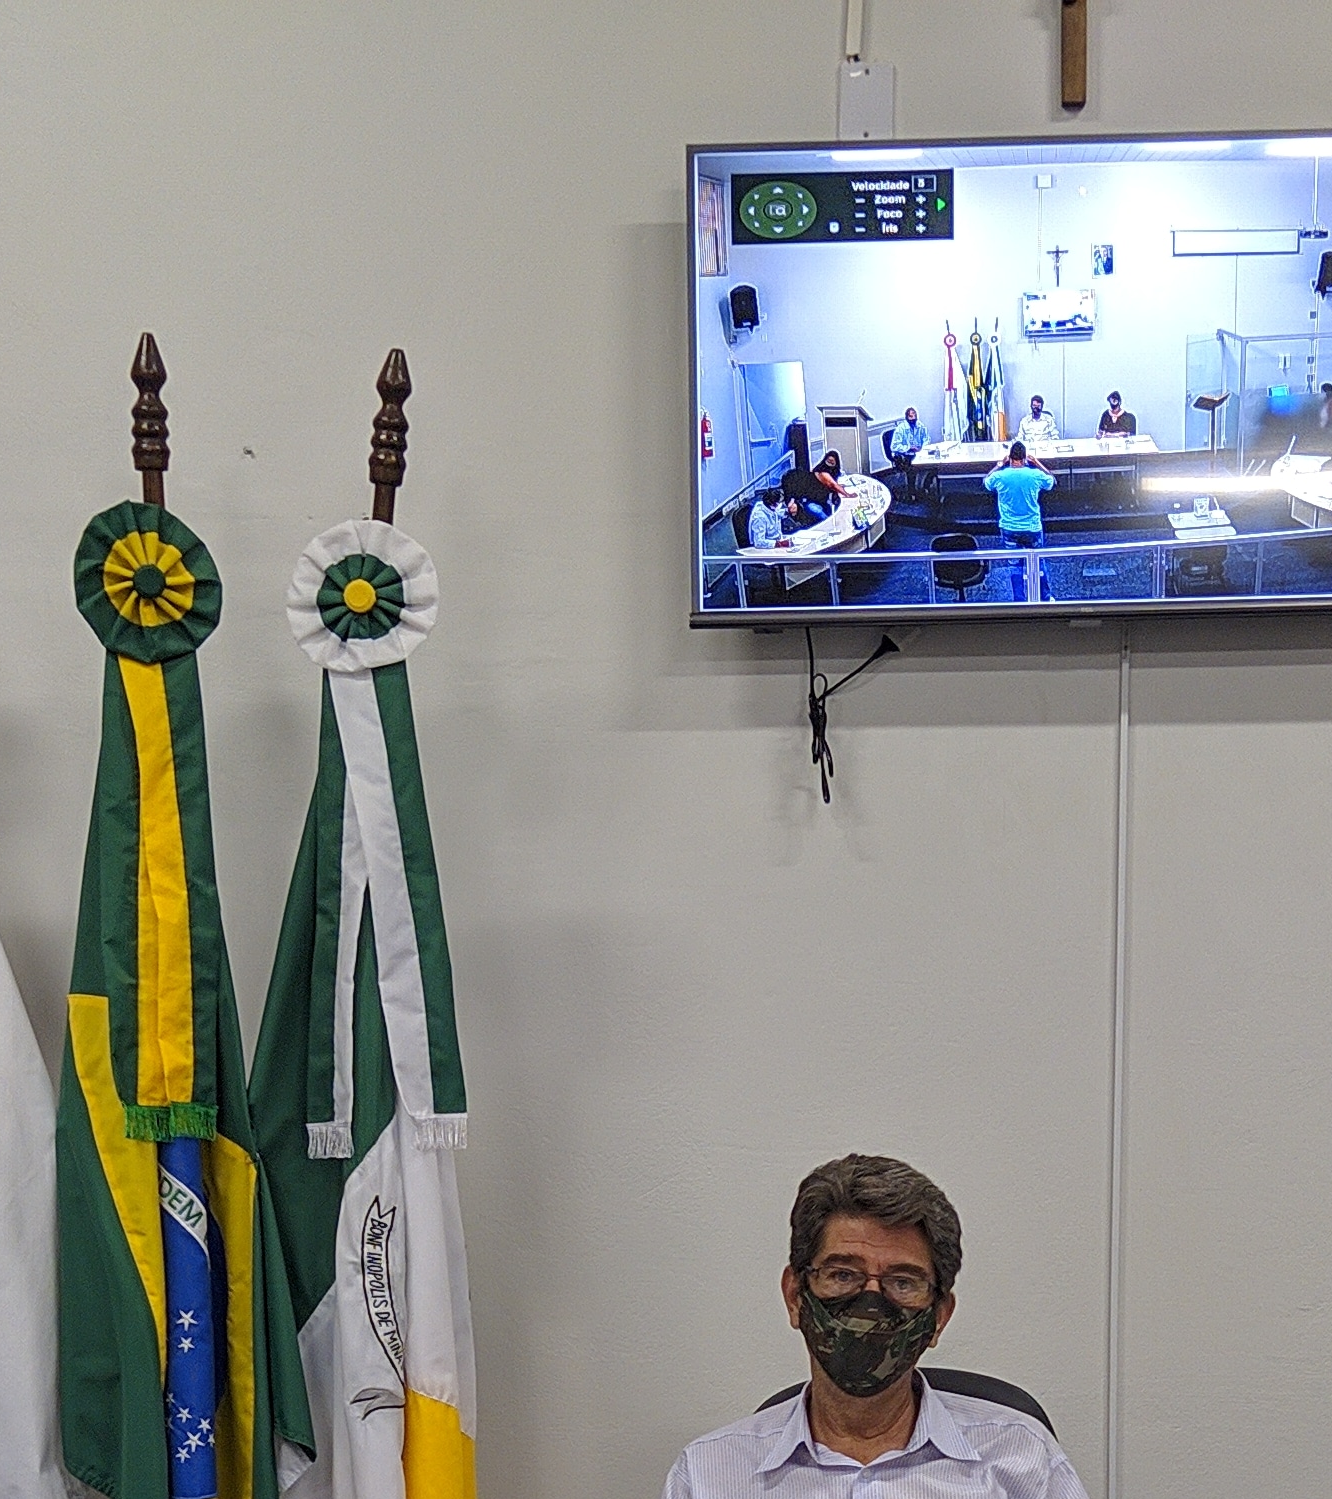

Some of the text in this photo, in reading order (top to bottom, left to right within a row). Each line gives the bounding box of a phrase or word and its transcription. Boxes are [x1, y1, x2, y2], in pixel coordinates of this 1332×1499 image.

[851, 179, 910, 192] Velocidade
[874, 194, 906, 205] Zoom
[876, 209, 903, 219] Foco
[375, 1311, 394, 1328] DE
